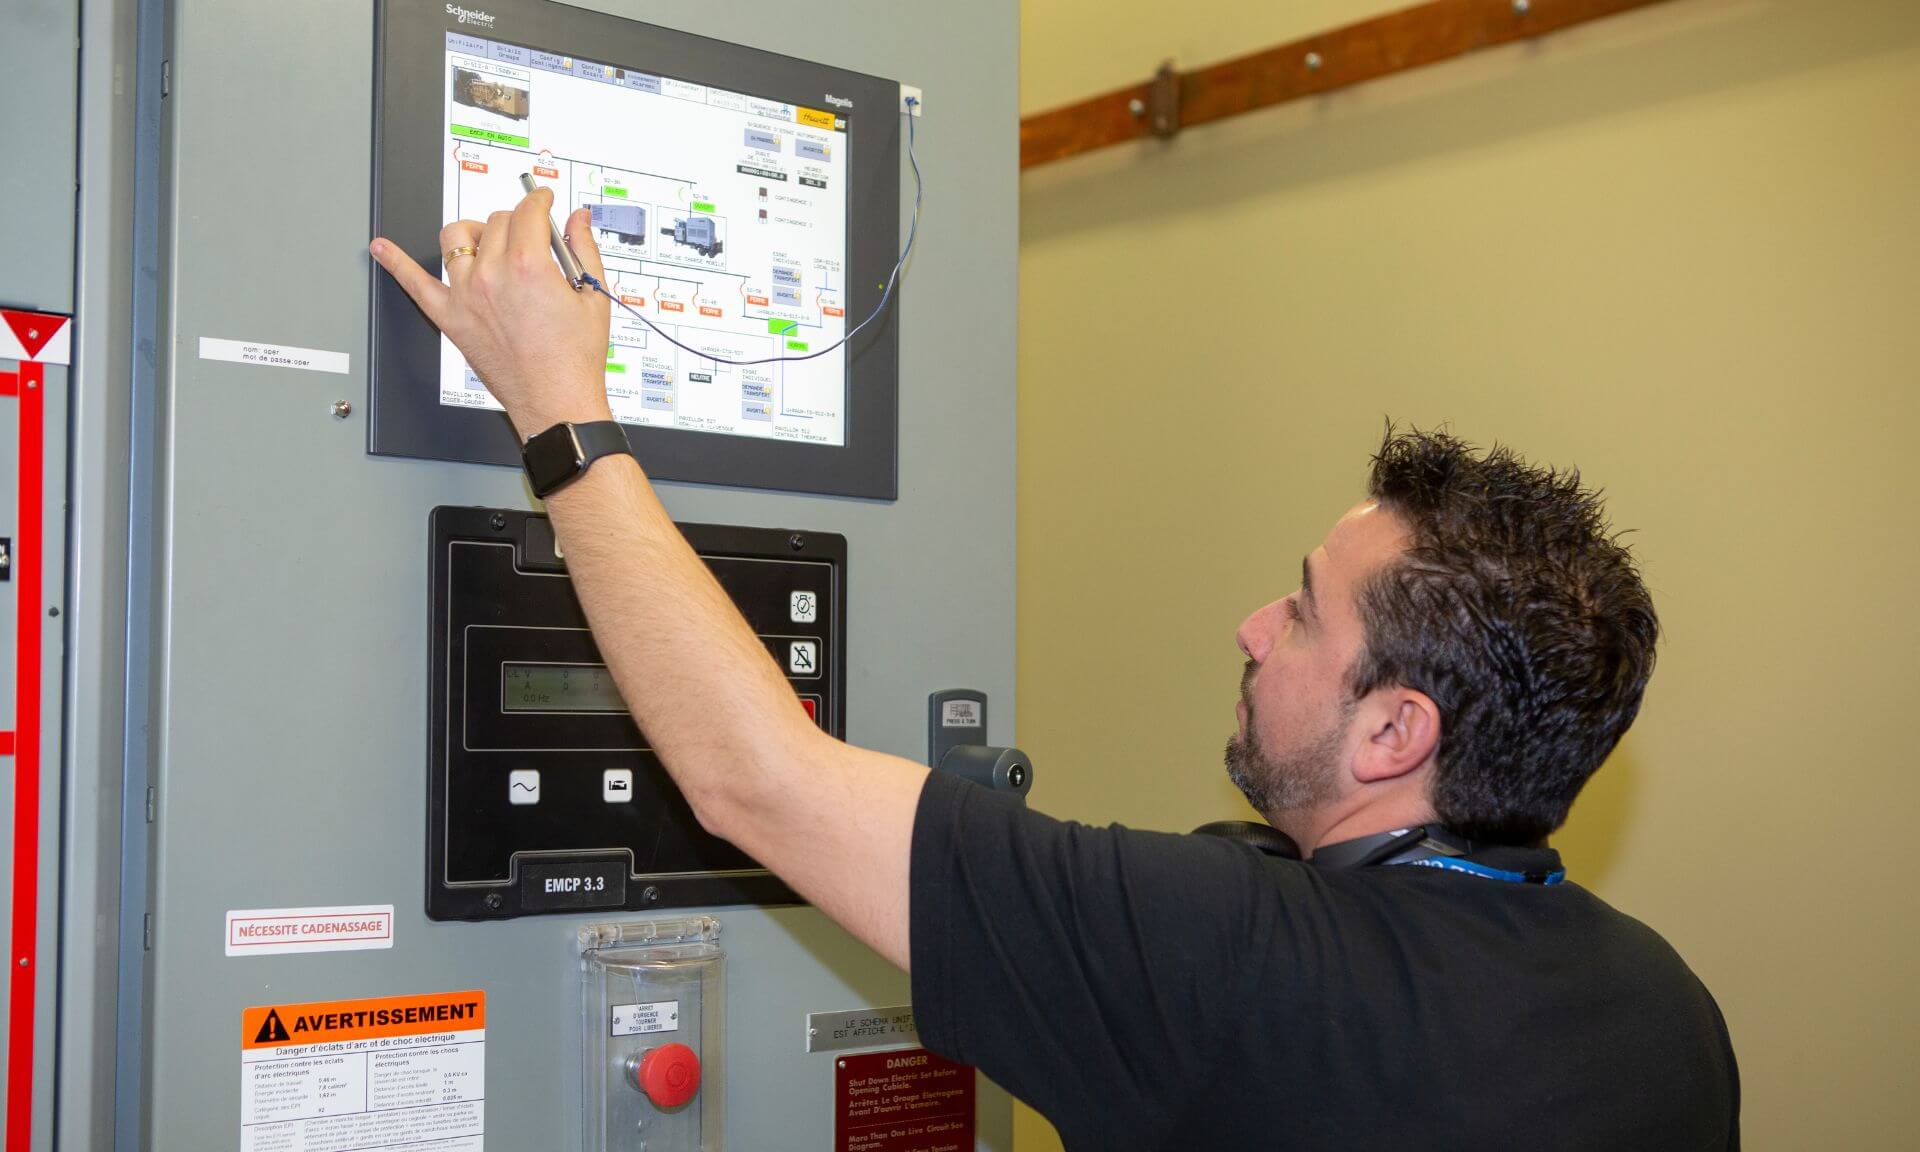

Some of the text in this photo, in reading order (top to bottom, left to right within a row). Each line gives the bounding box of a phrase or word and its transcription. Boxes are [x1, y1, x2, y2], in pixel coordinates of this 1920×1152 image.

[446, 4, 496, 23] Schneider
[471, 19, 495, 30] Electric
[447, 37, 483, 49] Unifilaire
[825, 93, 853, 109] Magelis
[263, 347, 280, 356] oper
[258, 354, 269, 362] de
[544, 876, 604, 893] EMCP 3.3
[239, 920, 383, 938] NÉCESSITE CADENASSAGE
[293, 1002, 478, 1033] AVERTISSEMENT
[845, 1019, 856, 1028] LE
[860, 1017, 889, 1028] SCHEMA
[833, 1029, 849, 1038] EST
[853, 1025, 886, 1036] AFFICHE
[890, 1025, 897, 1033] A
[275, 1047, 309, 1057] Danger
[346, 1039, 368, 1049] d'arc
[369, 1039, 379, 1047] et
[380, 1037, 391, 1046] de
[392, 1036, 413, 1045] choc
[374, 1051, 409, 1061] Protection
[886, 1054, 929, 1069] DANGER
[254, 1062, 289, 1072] Protection
[254, 1072, 272, 1080] d'arc
[848, 1069, 957, 1088] Shut Down Electric Set Before
[848, 1085, 881, 1097] Opening
[881, 1096, 891, 1104] Le
[892, 1092, 920, 1103] Groupe
[848, 1107, 872, 1116] Avant
[873, 1103, 902, 1113] D'ouvrir
[848, 1122, 965, 1144] More Than One Live Circuit See
[848, 1141, 883, 1152] Diagram.
